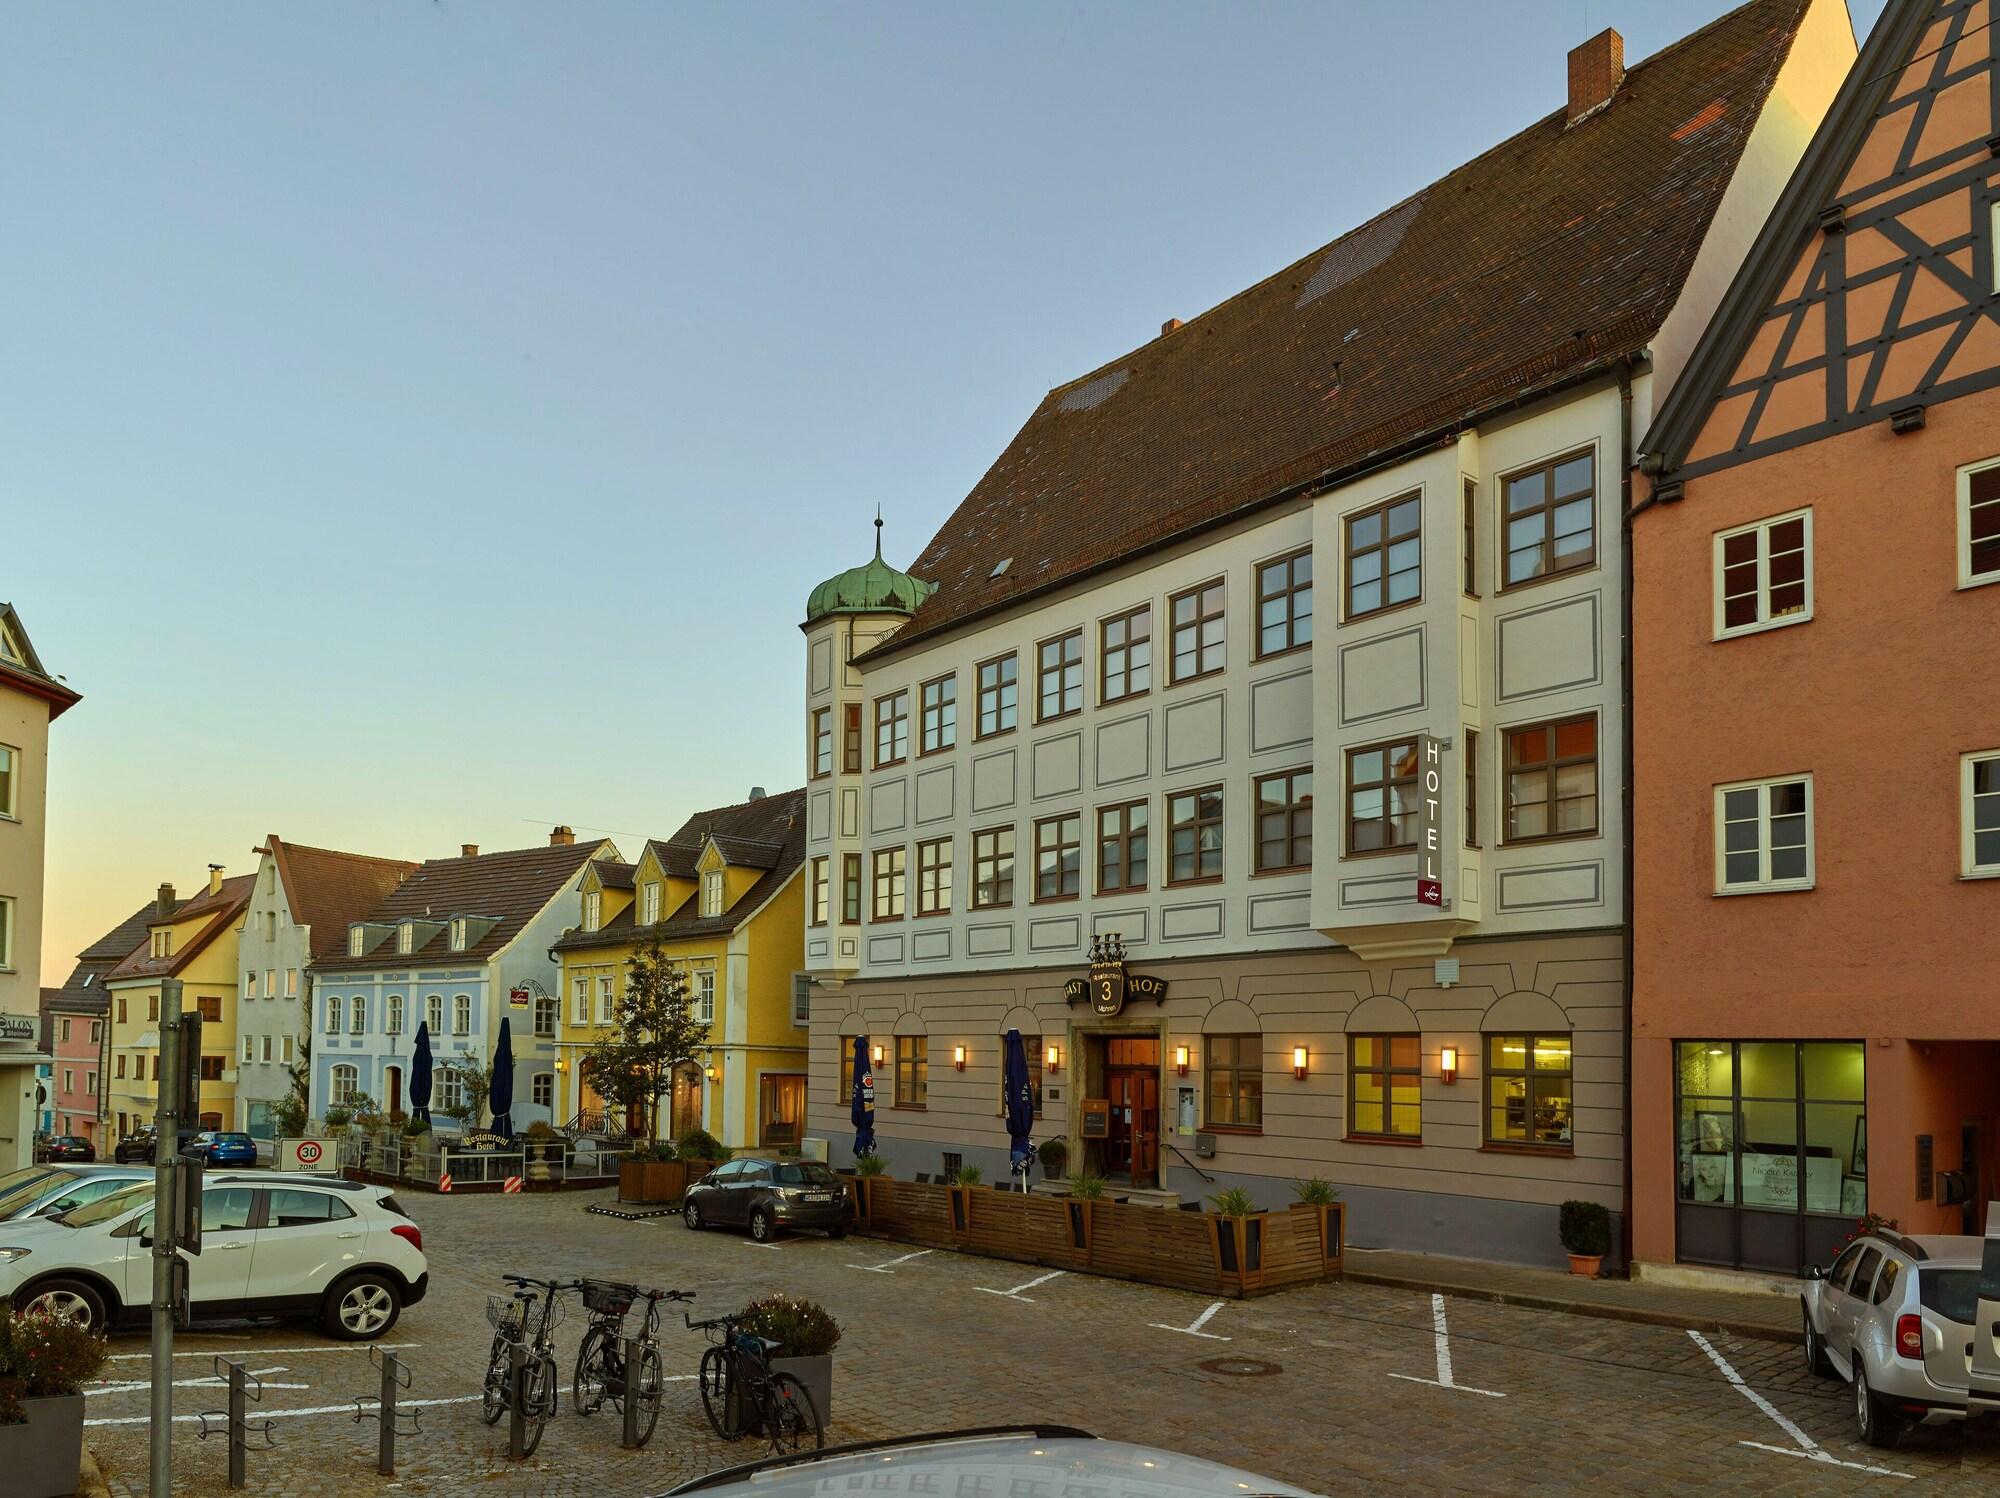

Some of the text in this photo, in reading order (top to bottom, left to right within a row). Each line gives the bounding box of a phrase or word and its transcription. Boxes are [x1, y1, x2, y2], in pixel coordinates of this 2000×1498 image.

[1426, 740, 1439, 879] HOTEL
[1063, 979, 1164, 999] GAST HOF
[1101, 981, 1112, 1001] 3
[463, 1132, 509, 1146] Restaurant
[476, 1142, 496, 1151] Hotel
[302, 1147, 317, 1158] 30
